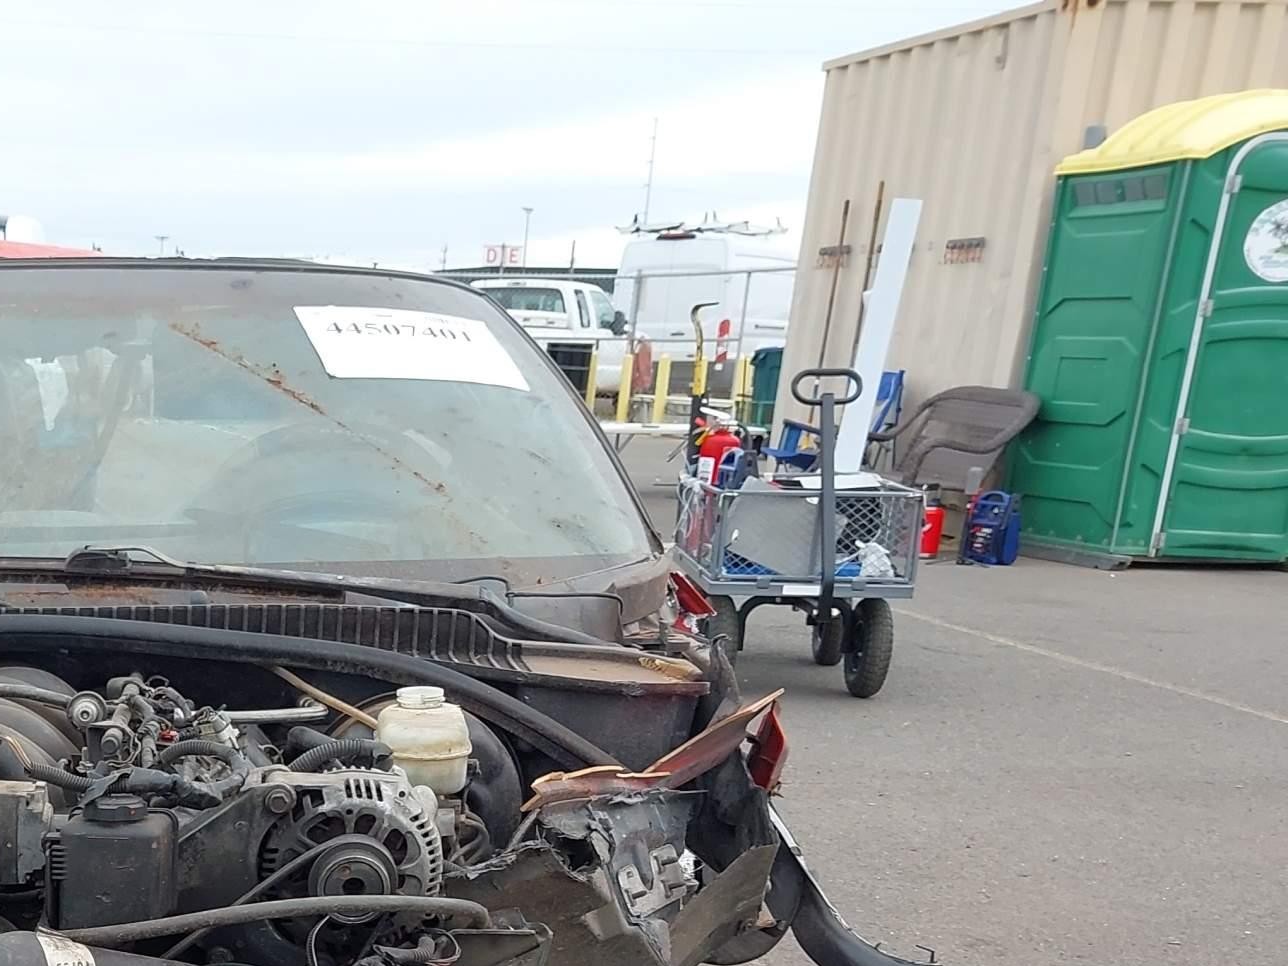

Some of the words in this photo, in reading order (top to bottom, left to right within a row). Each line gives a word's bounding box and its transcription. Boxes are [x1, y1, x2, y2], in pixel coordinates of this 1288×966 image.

[486, 247, 497, 263] D
[509, 247, 519, 264] E
[326, 321, 472, 342] 44507401
